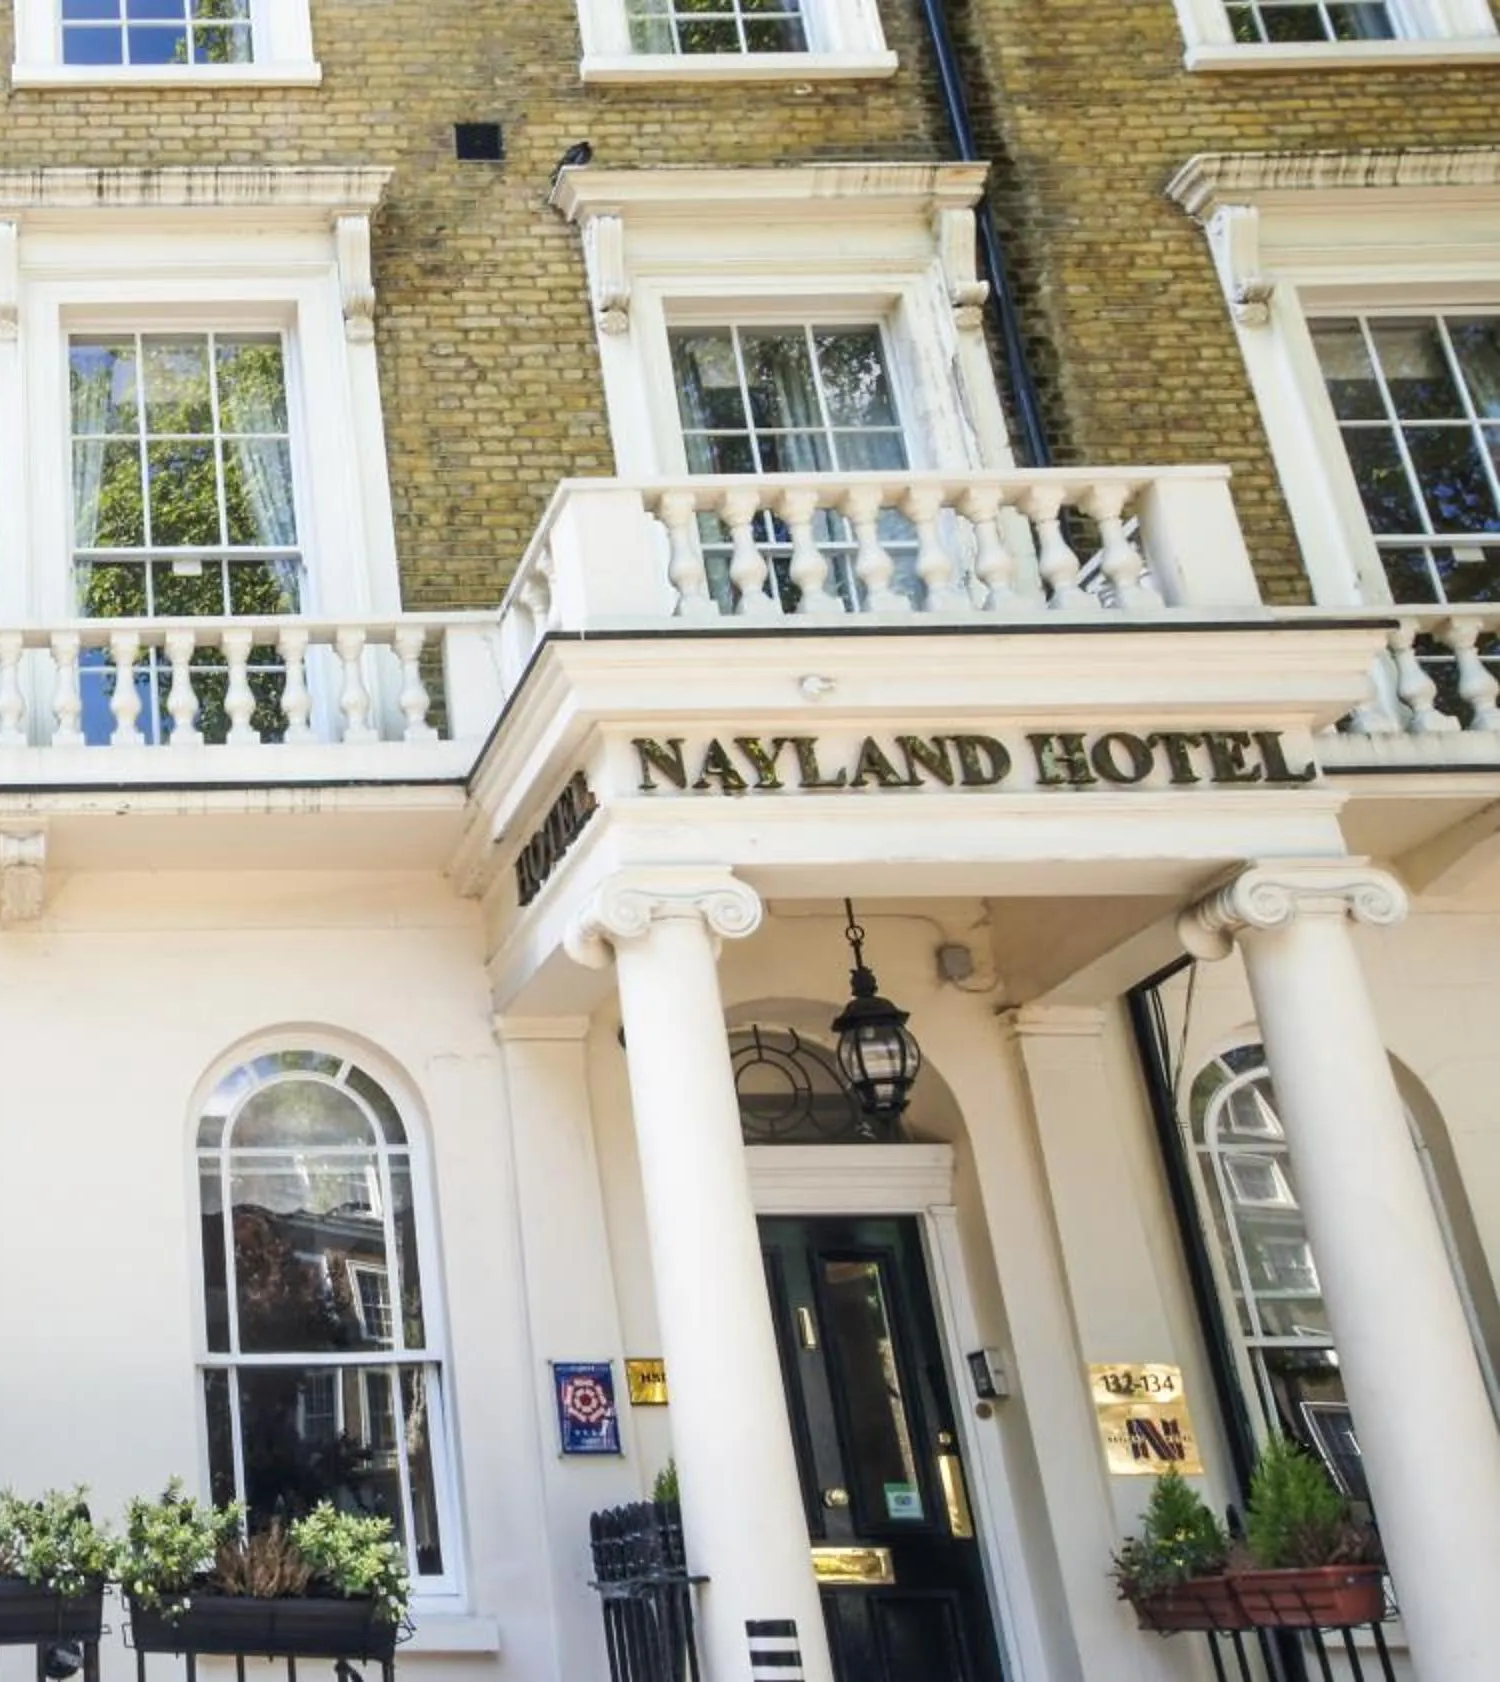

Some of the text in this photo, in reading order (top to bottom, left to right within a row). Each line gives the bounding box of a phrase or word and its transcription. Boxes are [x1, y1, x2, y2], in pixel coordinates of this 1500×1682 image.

[632, 731, 1316, 795] NAYLAND HOTEL
[1102, 1371, 1175, 1395] 132-134
